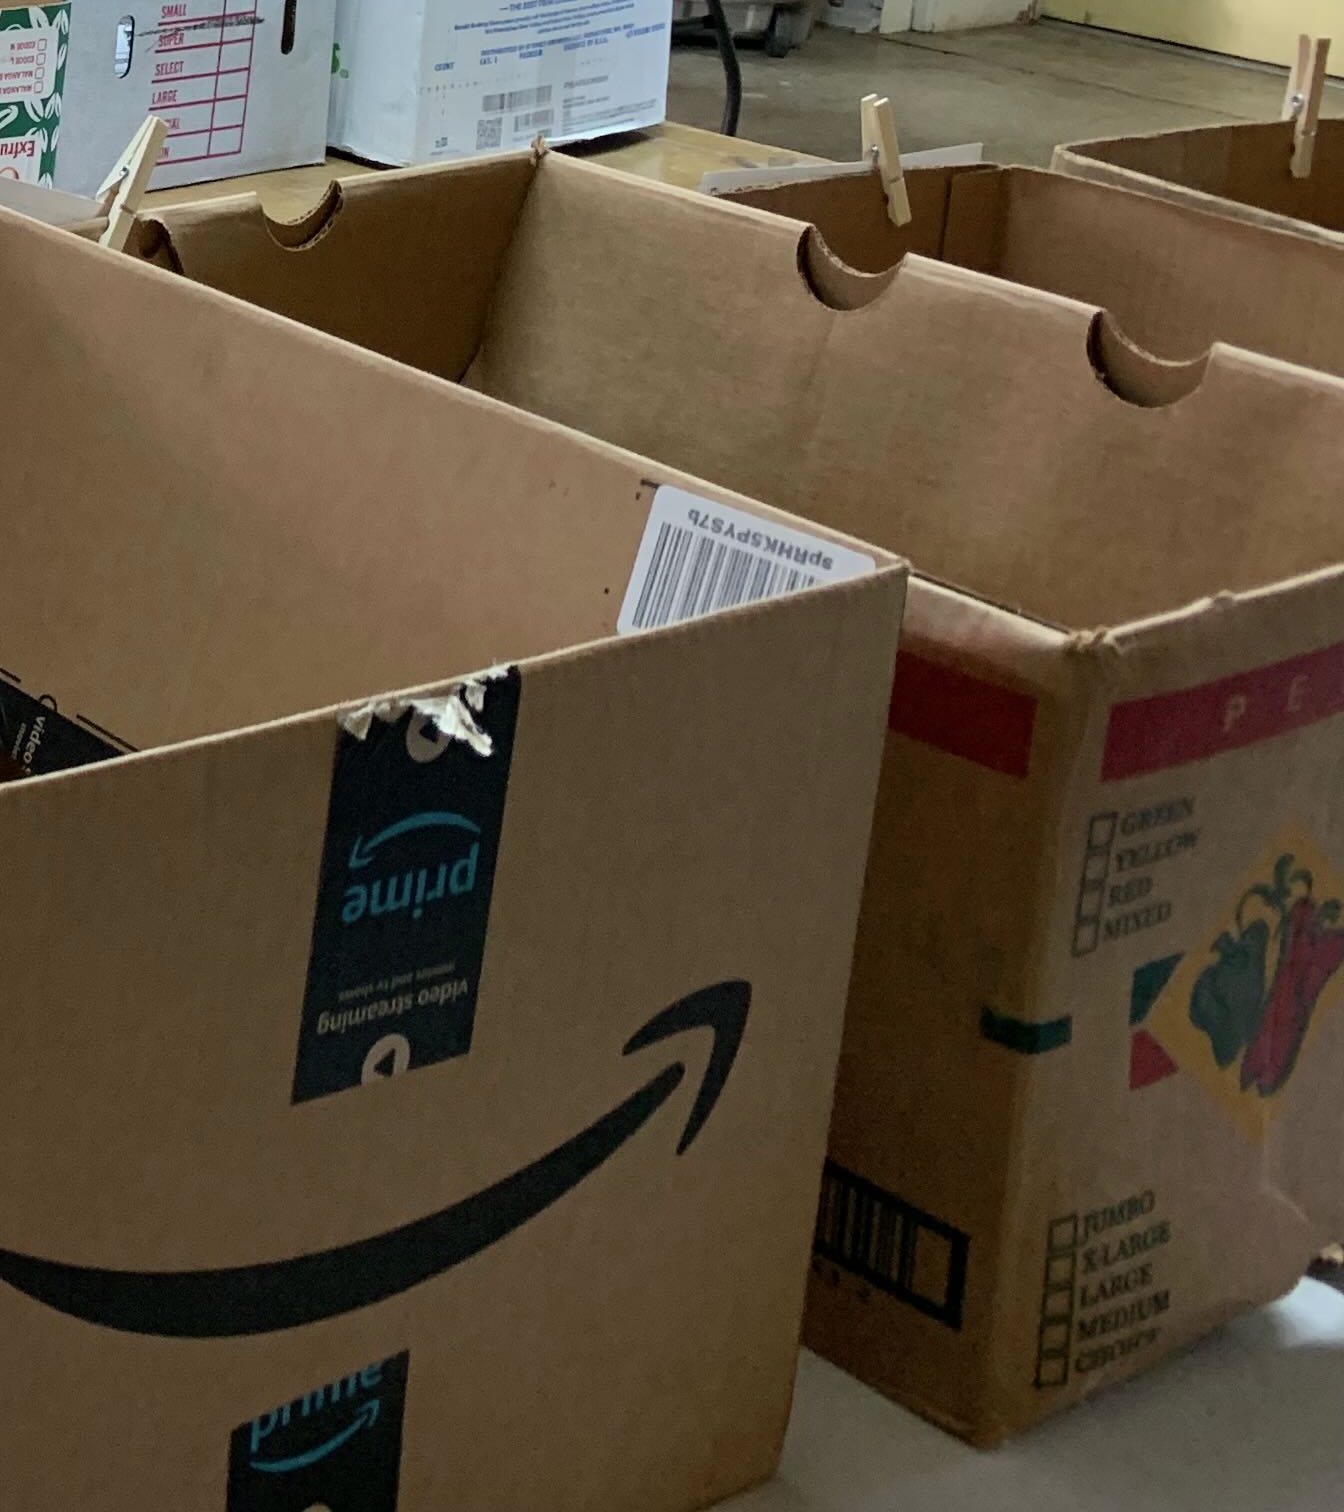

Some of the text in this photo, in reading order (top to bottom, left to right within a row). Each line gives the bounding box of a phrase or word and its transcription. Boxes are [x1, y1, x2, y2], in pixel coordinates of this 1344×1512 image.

[161, 3, 187, 18] SMALL
[157, 31, 184, 48] SUPER
[154, 59, 184, 76] SELECT
[151, 89, 179, 105] LARGE
[22, 715, 46, 764] video
[1120, 796, 1195, 836] GREEN
[1115, 826, 1201, 872] YELLOW
[340, 840, 482, 926] prime
[1108, 875, 1154, 907] RED
[1102, 900, 1173, 942] MIXED
[316, 976, 469, 1036] video streaming
[1077, 1189, 1156, 1248] JUMBO
[1079, 1262, 1154, 1310] LARGE
[1077, 1289, 1170, 1339] MEDIUM
